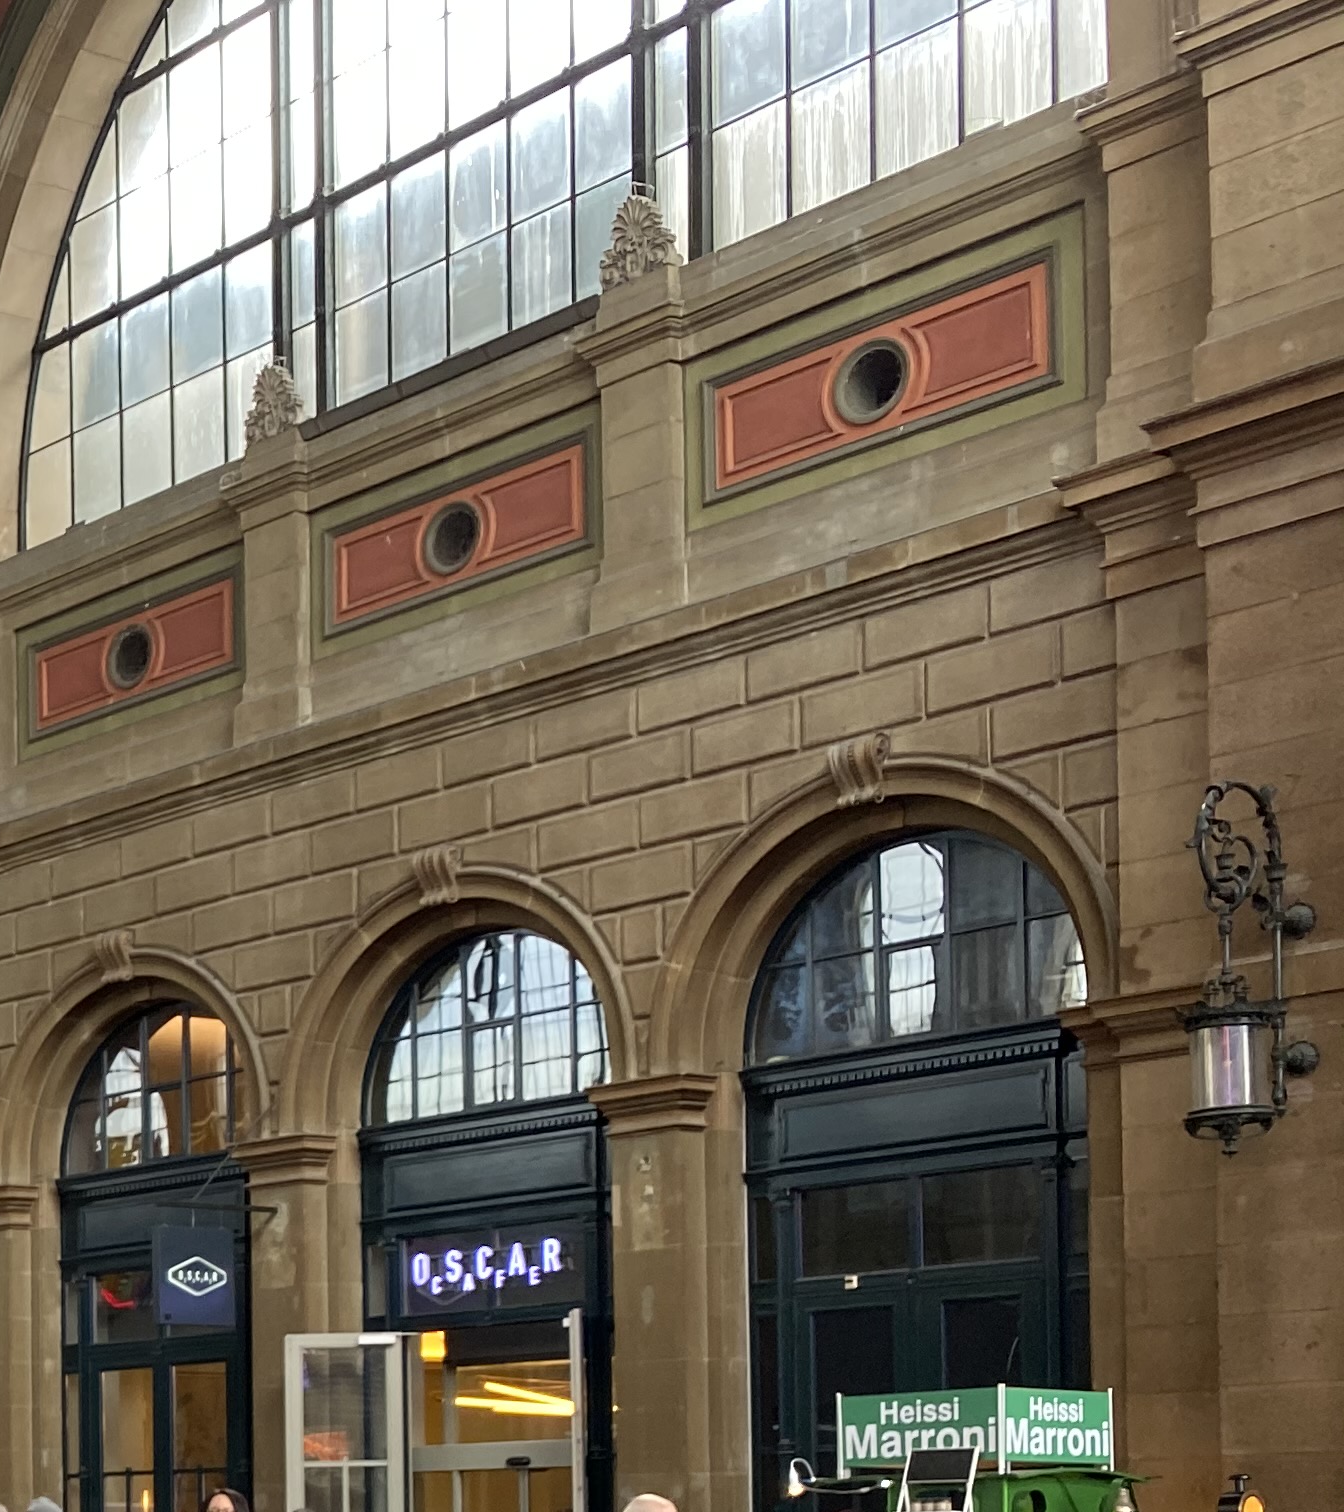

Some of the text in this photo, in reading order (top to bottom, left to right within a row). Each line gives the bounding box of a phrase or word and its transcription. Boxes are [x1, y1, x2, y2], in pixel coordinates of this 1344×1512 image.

[412, 1237, 563, 1287] OSCAR
[879, 1396, 960, 1425] Heissi
[1029, 1396, 1084, 1423] Heissi
[845, 1416, 998, 1461] Marroni
[1006, 1416, 1110, 1458] Marroni
